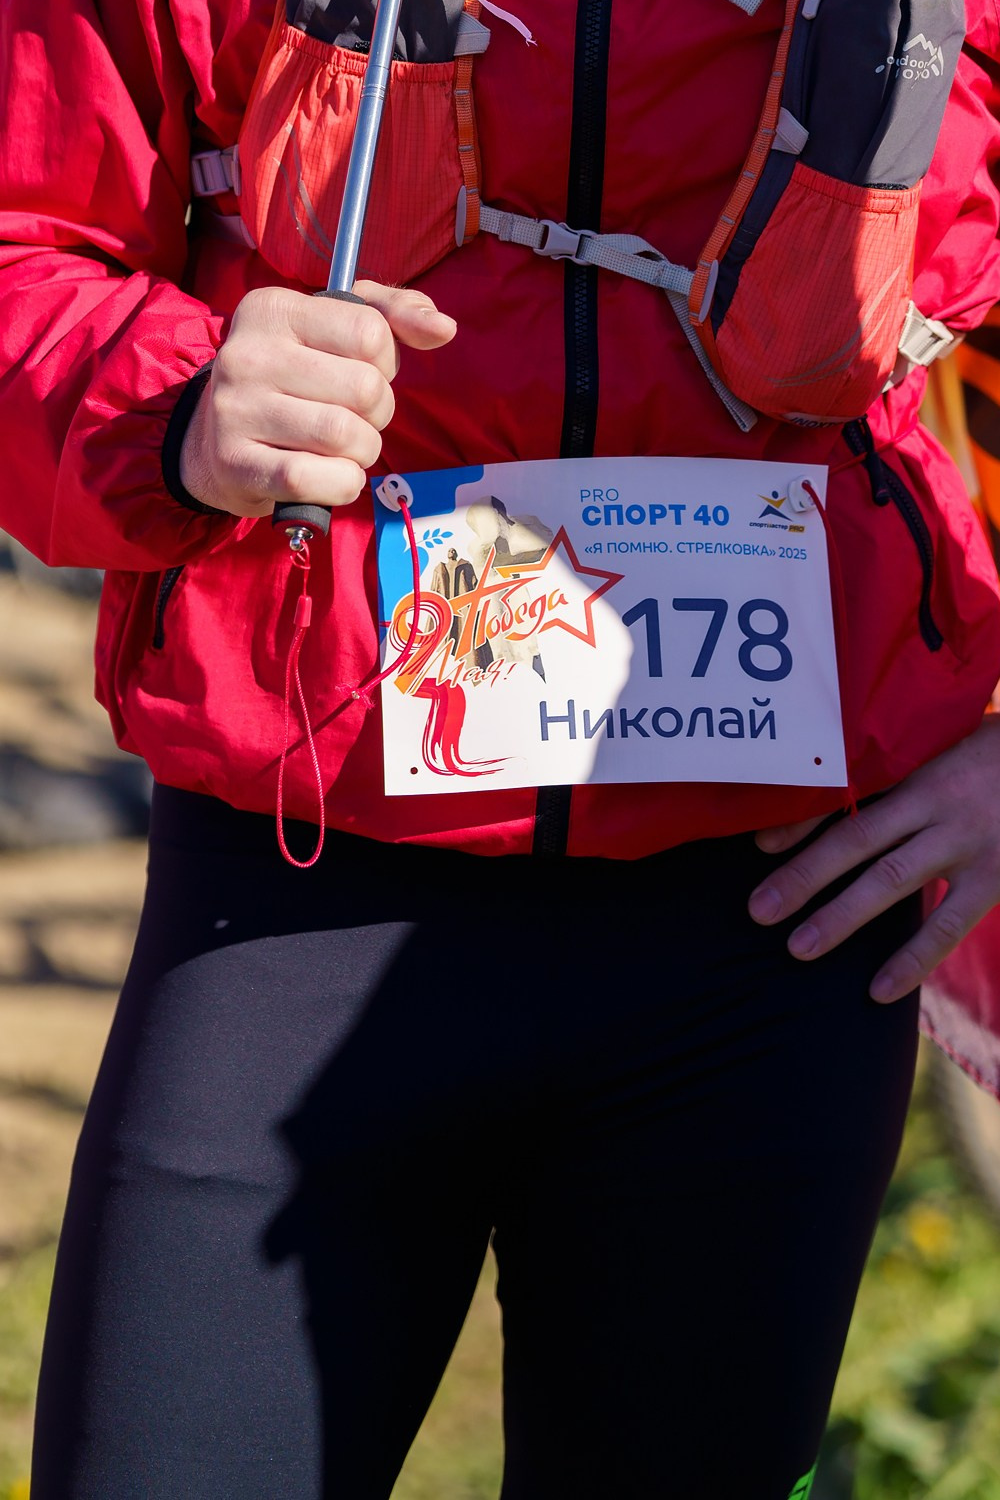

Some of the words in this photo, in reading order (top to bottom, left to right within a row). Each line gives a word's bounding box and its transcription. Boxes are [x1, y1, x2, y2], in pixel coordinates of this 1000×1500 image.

[580, 488, 619, 502] PRO
[581, 503, 687, 527] СПОРТ
[693, 505, 730, 527] 40
[584, 542, 602, 555] «Я
[607, 541, 673, 554] ПОМНЮ.
[676, 542, 776, 557] СТРЕЛКОВКА»
[779, 546, 808, 560] 2025
[449, 545, 569, 662] Победа
[622, 597, 793, 682] 178
[540, 697, 777, 742] Николай
